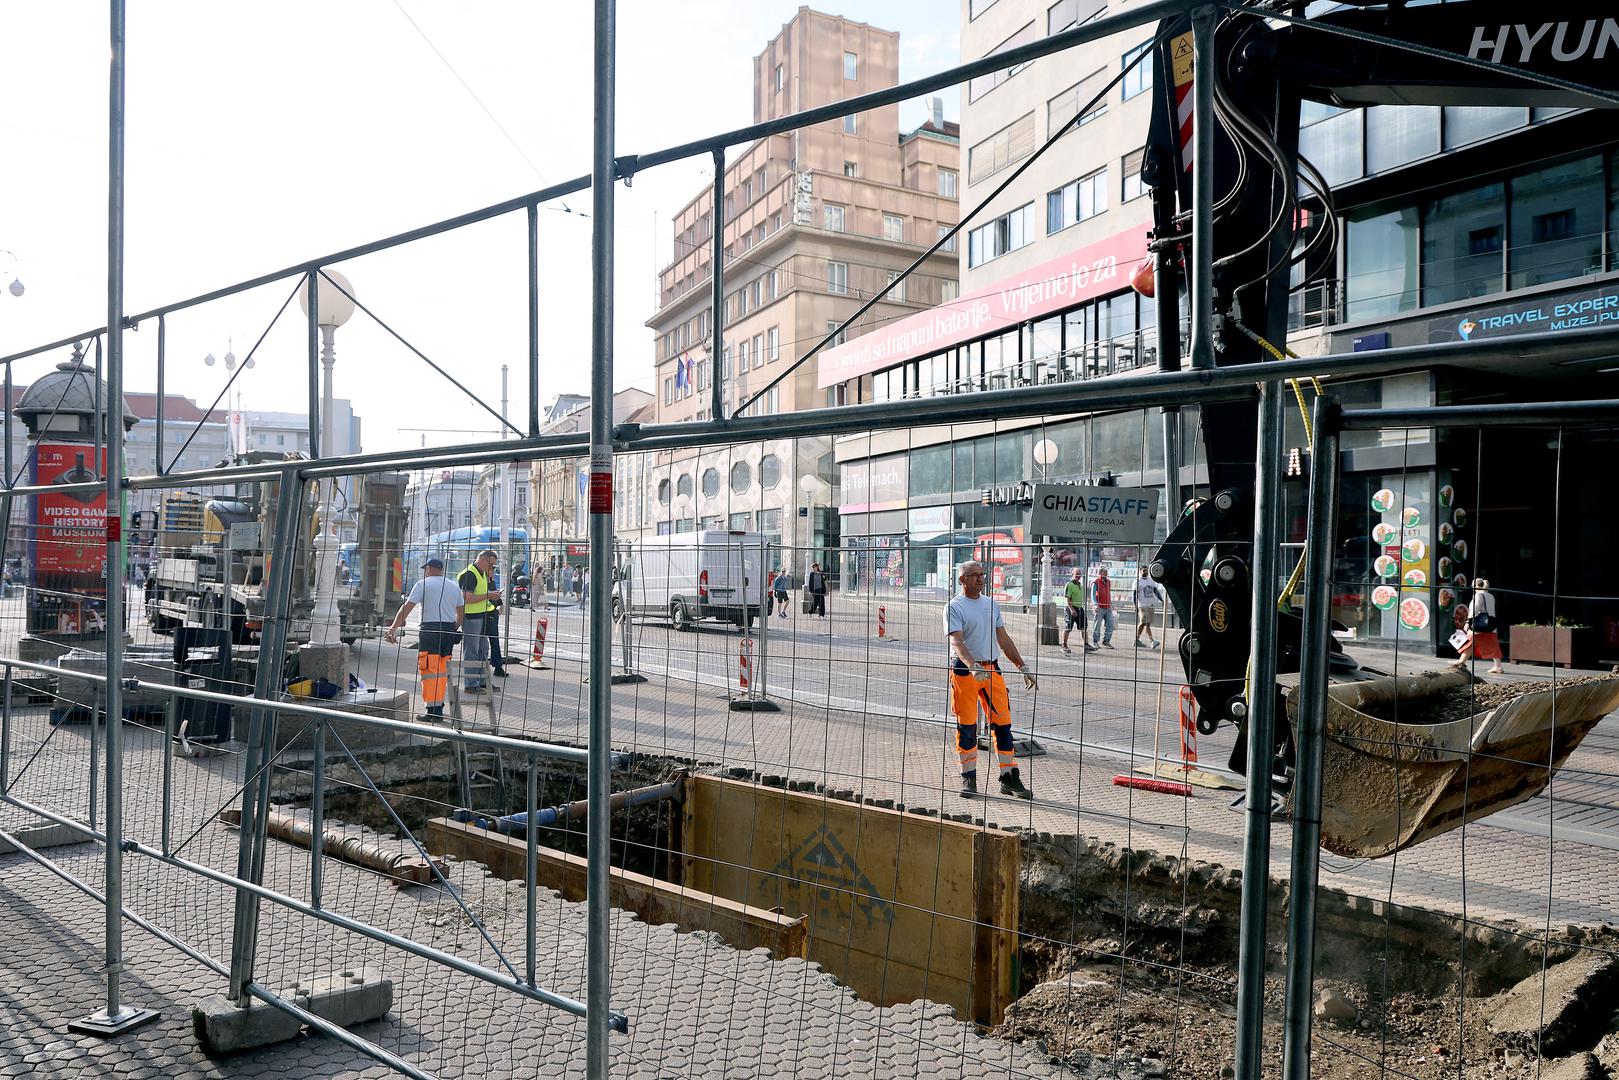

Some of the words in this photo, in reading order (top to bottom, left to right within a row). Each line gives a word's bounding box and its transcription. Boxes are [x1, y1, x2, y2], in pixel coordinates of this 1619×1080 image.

[1467, 18, 1619, 64] HYUN
[892, 318, 933, 354] napuni
[936, 301, 992, 338] baterije.
[1001, 272, 1068, 314] Vrijeme
[1070, 262, 1089, 298] je
[1092, 255, 1117, 285] za
[1479, 308, 1549, 330] TRAVEL
[1554, 295, 1618, 317] EXPER
[1551, 314, 1598, 331] MUZEJ
[44, 507, 79, 516] VIDEO
[81, 507, 107, 517] GAM
[1043, 494, 1150, 515] GHIASTAFF
[53, 517, 105, 527] HISTORY
[1058, 515, 1083, 523] NAJAM
[1089, 517, 1125, 526] PRODAJA
[52, 528, 106, 537] MUSEUM
